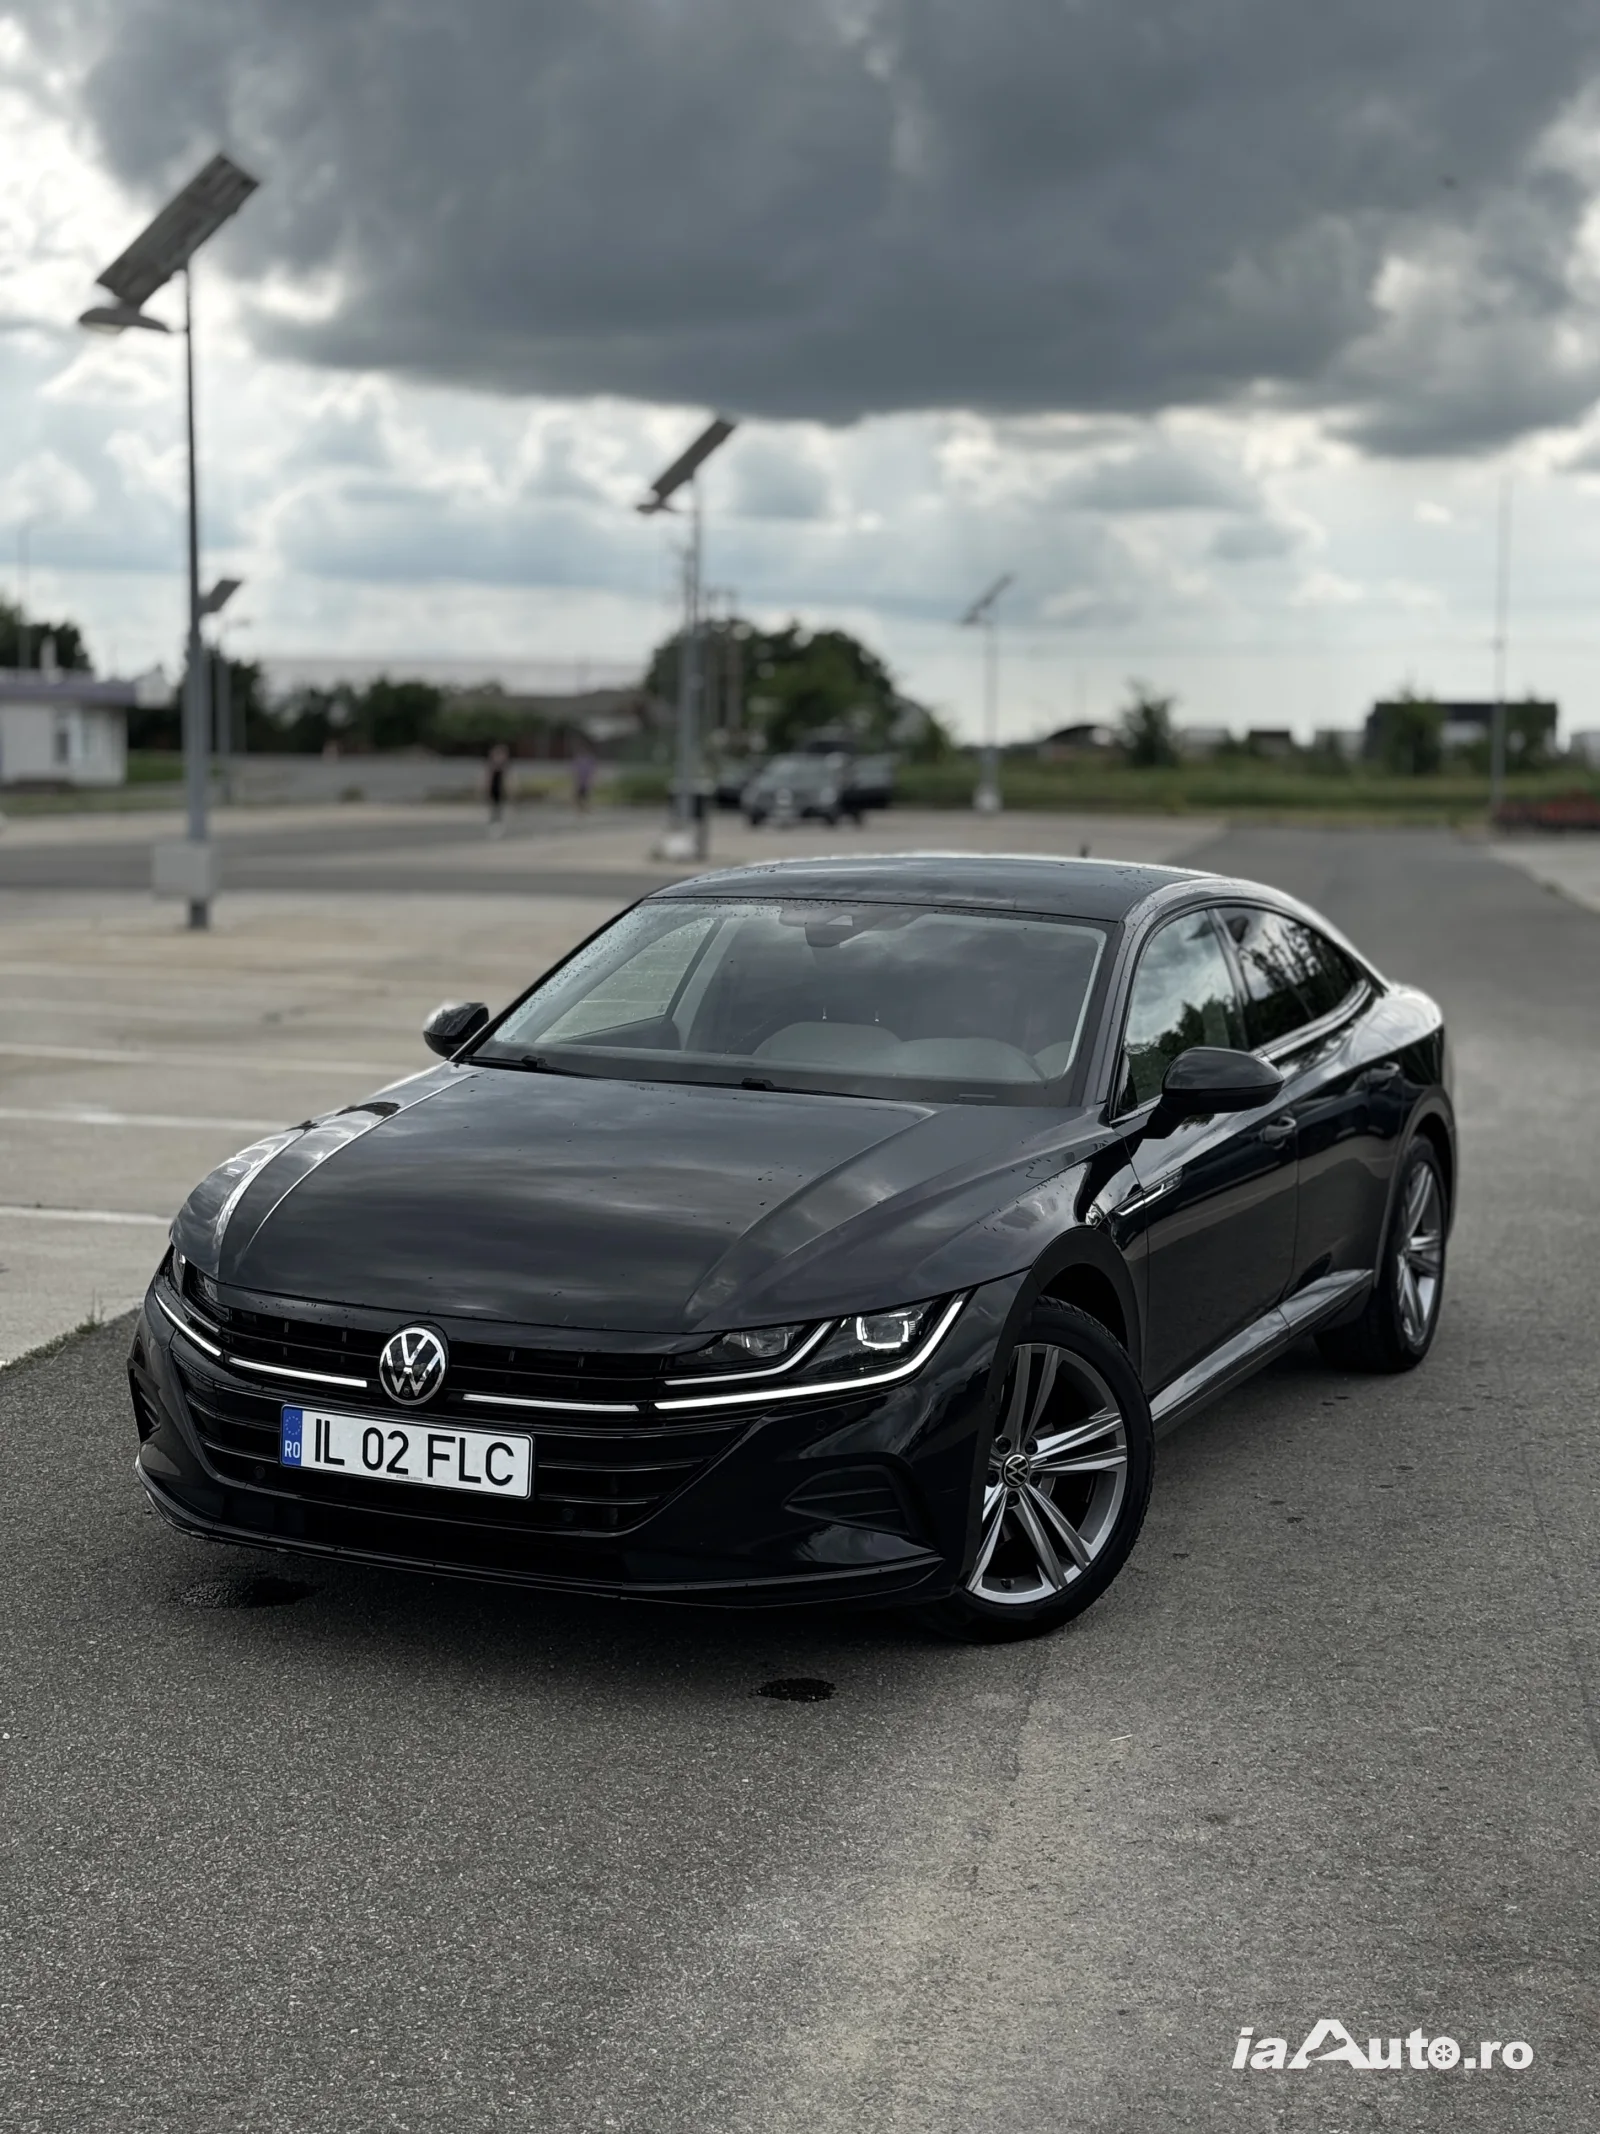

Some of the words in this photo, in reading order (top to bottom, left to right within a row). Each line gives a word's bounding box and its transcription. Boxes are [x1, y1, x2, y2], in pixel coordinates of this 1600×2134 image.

[284, 1440, 301, 1459] RO
[315, 1418, 345, 1466] IL
[362, 1427, 409, 1475] 02
[427, 1433, 514, 1486] FLC
